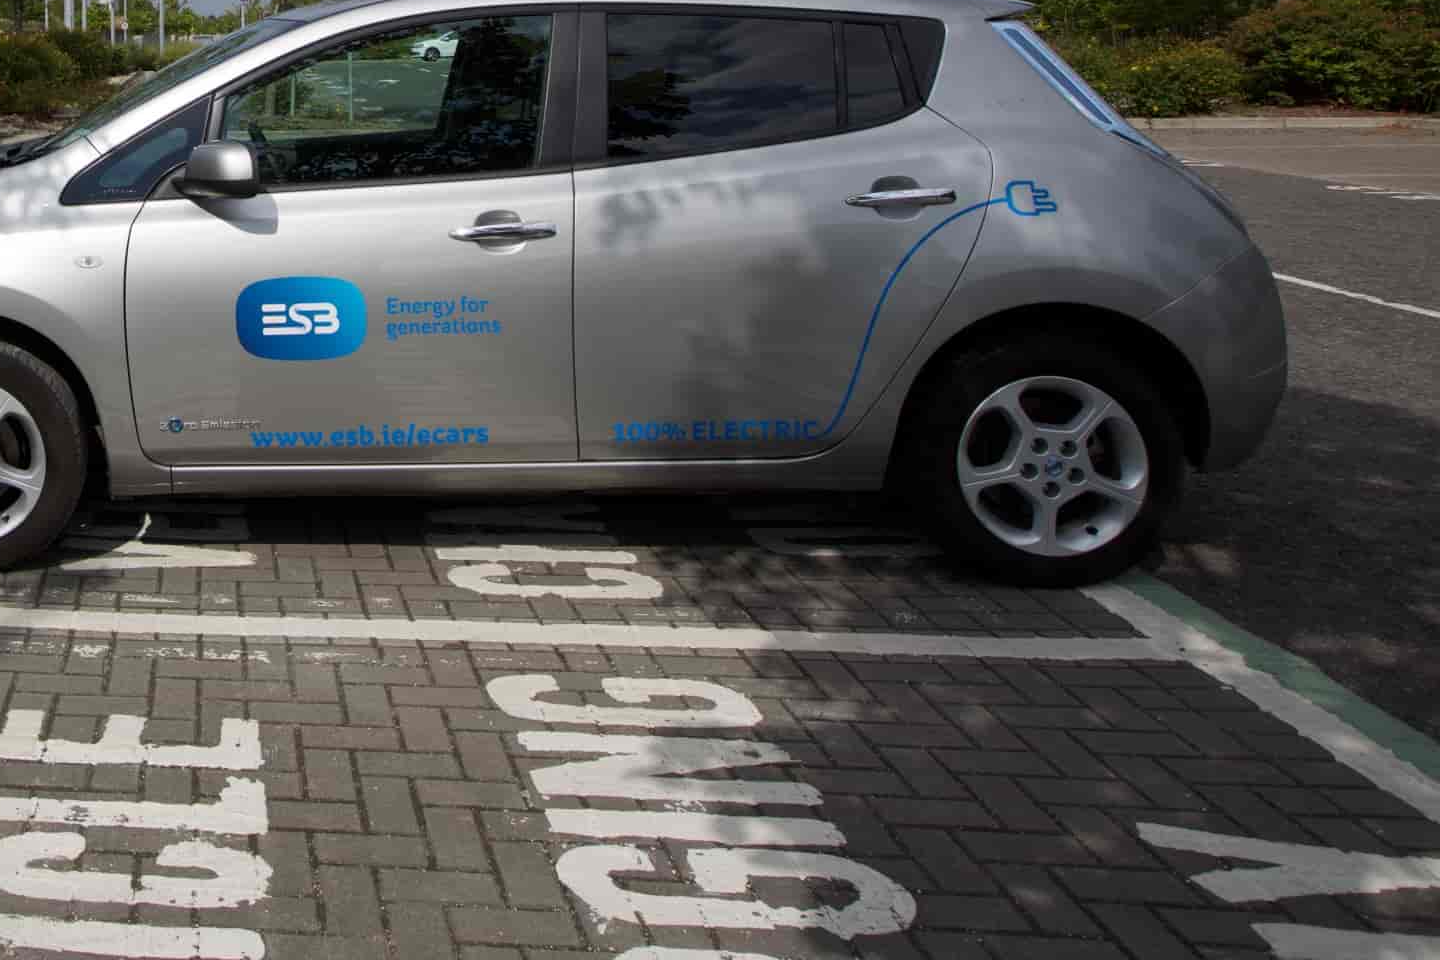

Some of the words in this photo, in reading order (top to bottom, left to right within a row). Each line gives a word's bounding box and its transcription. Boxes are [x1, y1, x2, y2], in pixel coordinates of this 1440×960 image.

[261, 302, 340, 336] ESB
[385, 296, 455, 319] Energy
[460, 295, 491, 314] for
[385, 318, 502, 341] generations
[250, 423, 490, 448] www.esb.ie/ecars
[612, 420, 688, 442] 100%
[691, 419, 820, 442] ELECTRIC
